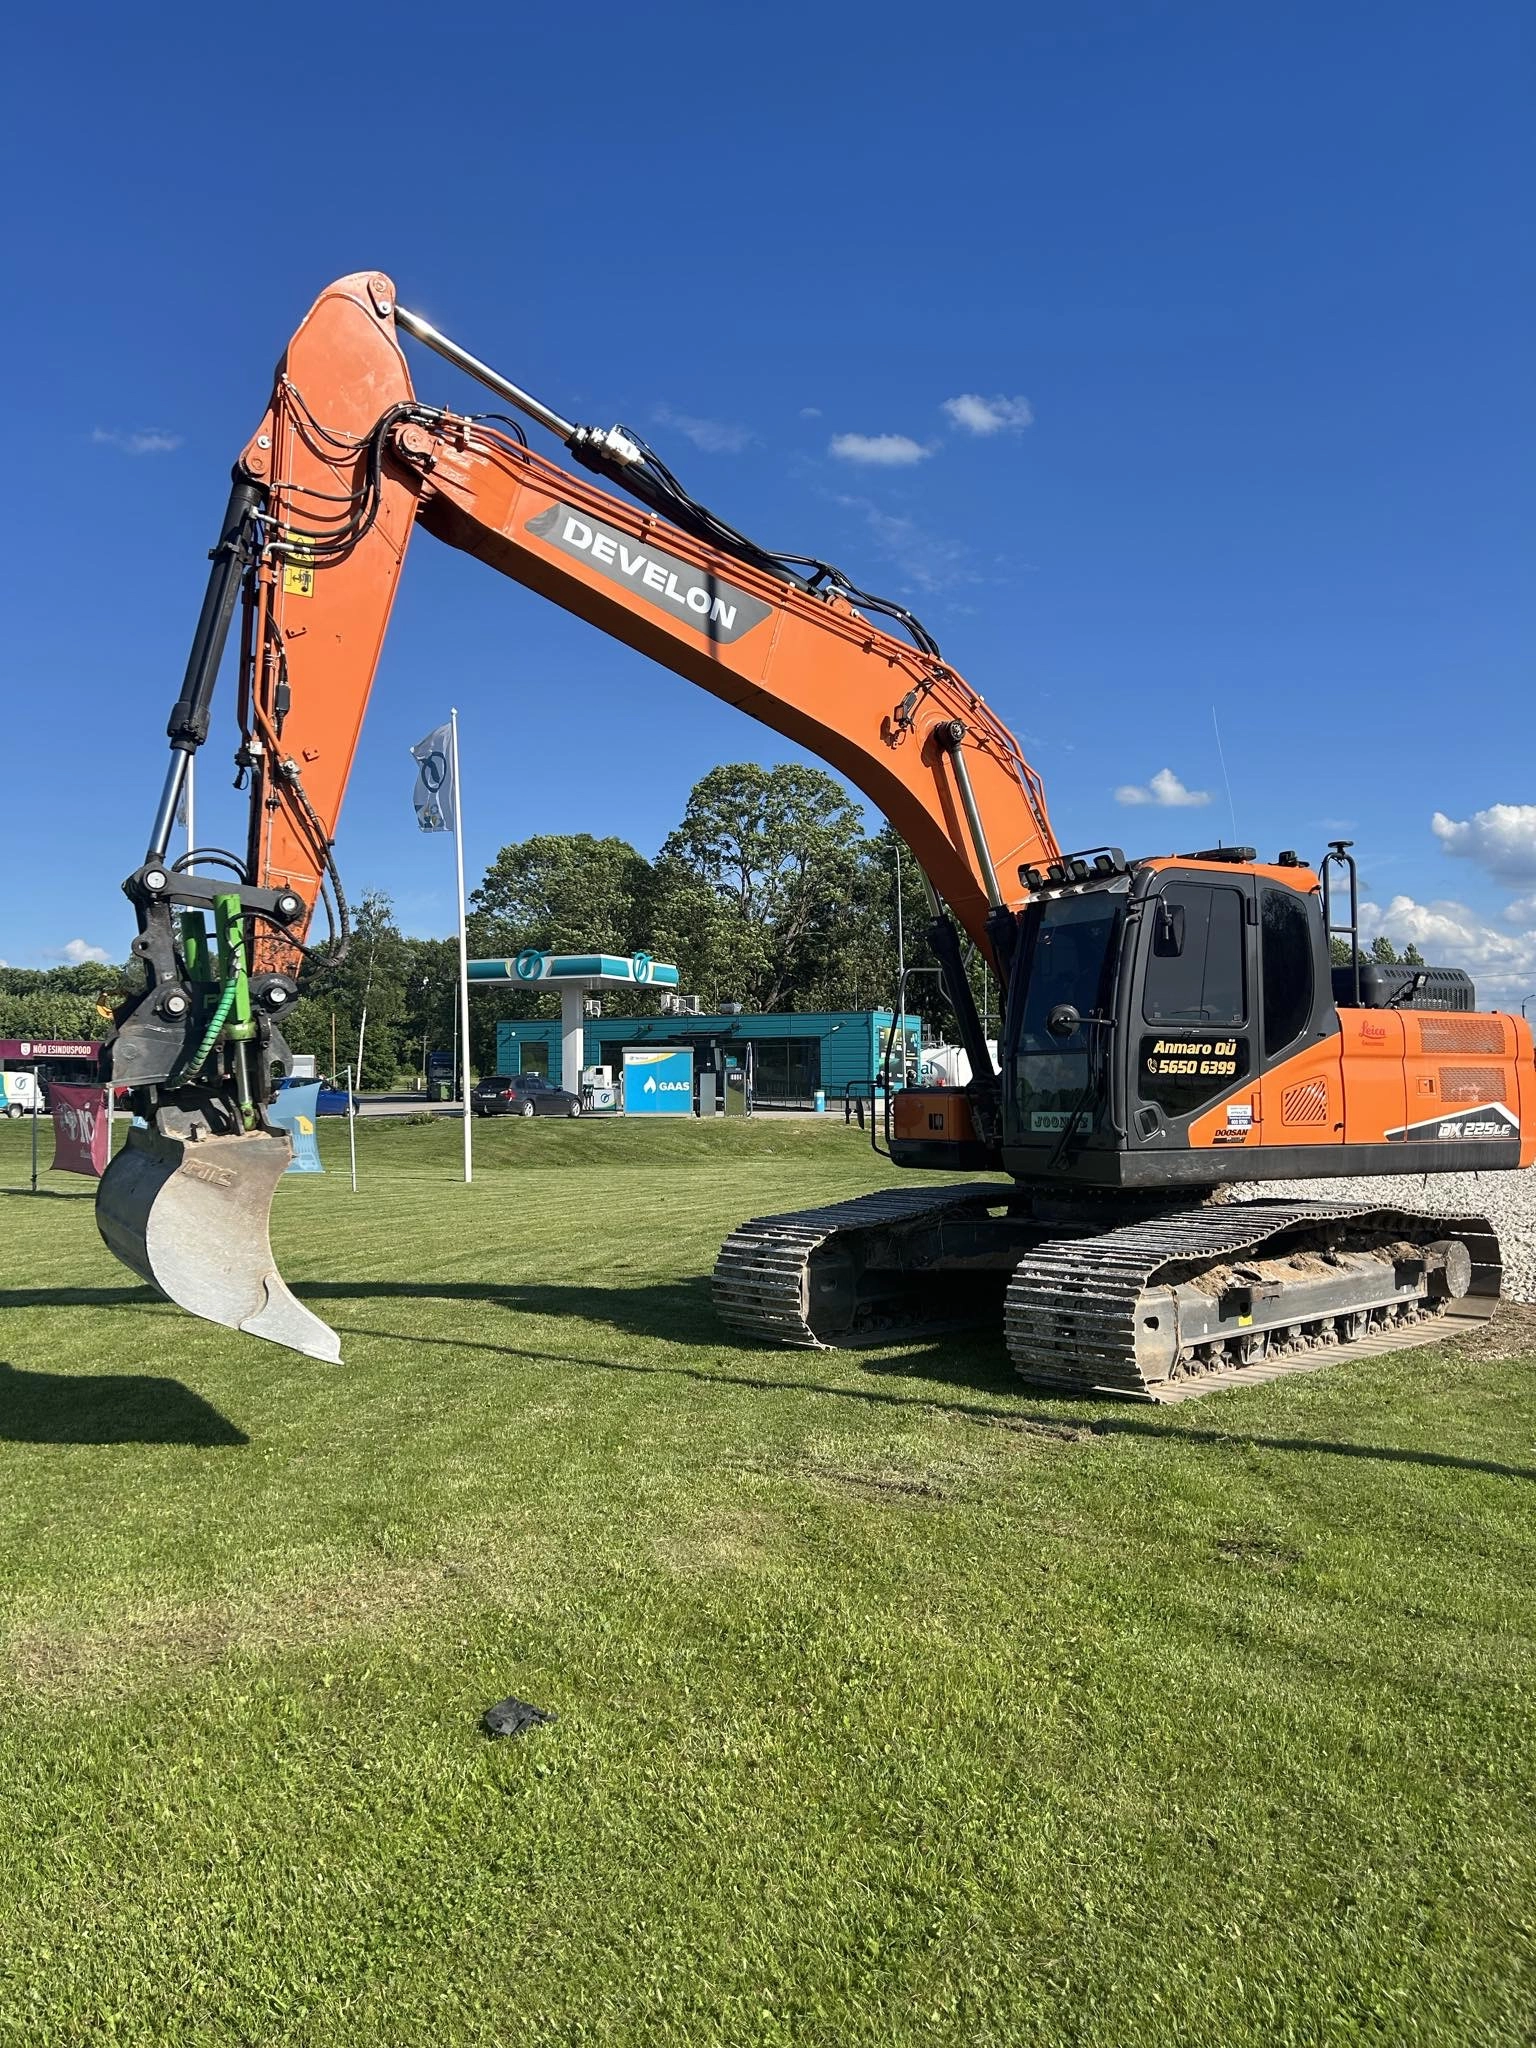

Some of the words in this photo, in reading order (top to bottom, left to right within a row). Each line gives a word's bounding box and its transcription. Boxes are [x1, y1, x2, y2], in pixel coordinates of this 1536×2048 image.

[562, 516, 737, 631] DEVELON
[1359, 1020, 1387, 1039] Leica
[33, 1043, 47, 1054] NÕO
[48, 1045, 92, 1055] ESINDUSPOOD
[1152, 1040, 1212, 1055] Anmaro
[1214, 1038, 1237, 1056] OÜ
[1158, 1060, 1198, 1074] 5650
[1200, 1061, 1236, 1075] 6399
[659, 1081, 690, 1092] GAAS
[1034, 1116, 1089, 1129] JOONS
[1438, 1122, 1463, 1138] DX
[1215, 1129, 1249, 1137] DOOSAN
